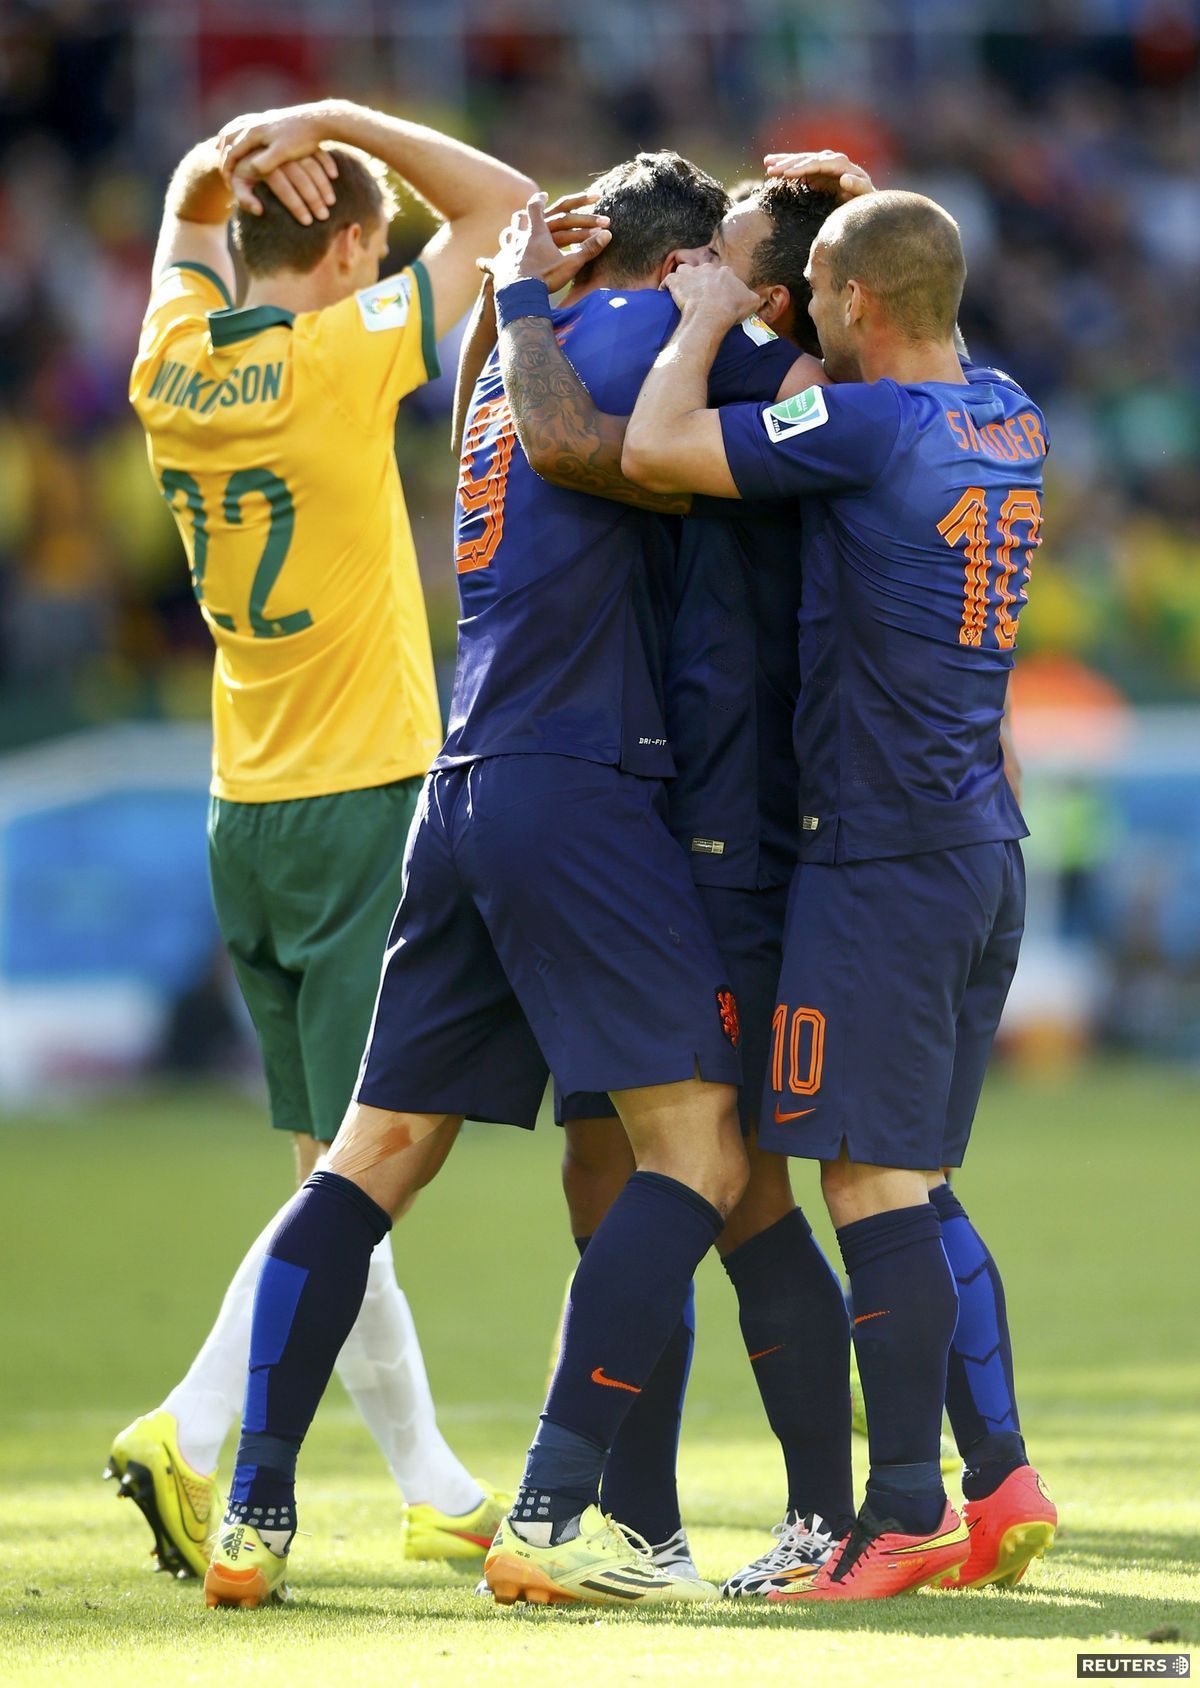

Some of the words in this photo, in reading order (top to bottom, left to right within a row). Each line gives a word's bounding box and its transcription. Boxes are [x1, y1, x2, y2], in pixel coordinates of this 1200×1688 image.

[160, 467, 314, 638] 22
[936, 487, 1044, 650] 10
[638, 737, 667, 746] DRI-FIT
[772, 1004, 826, 1096] 10
[230, 1527, 245, 1561] adidas
